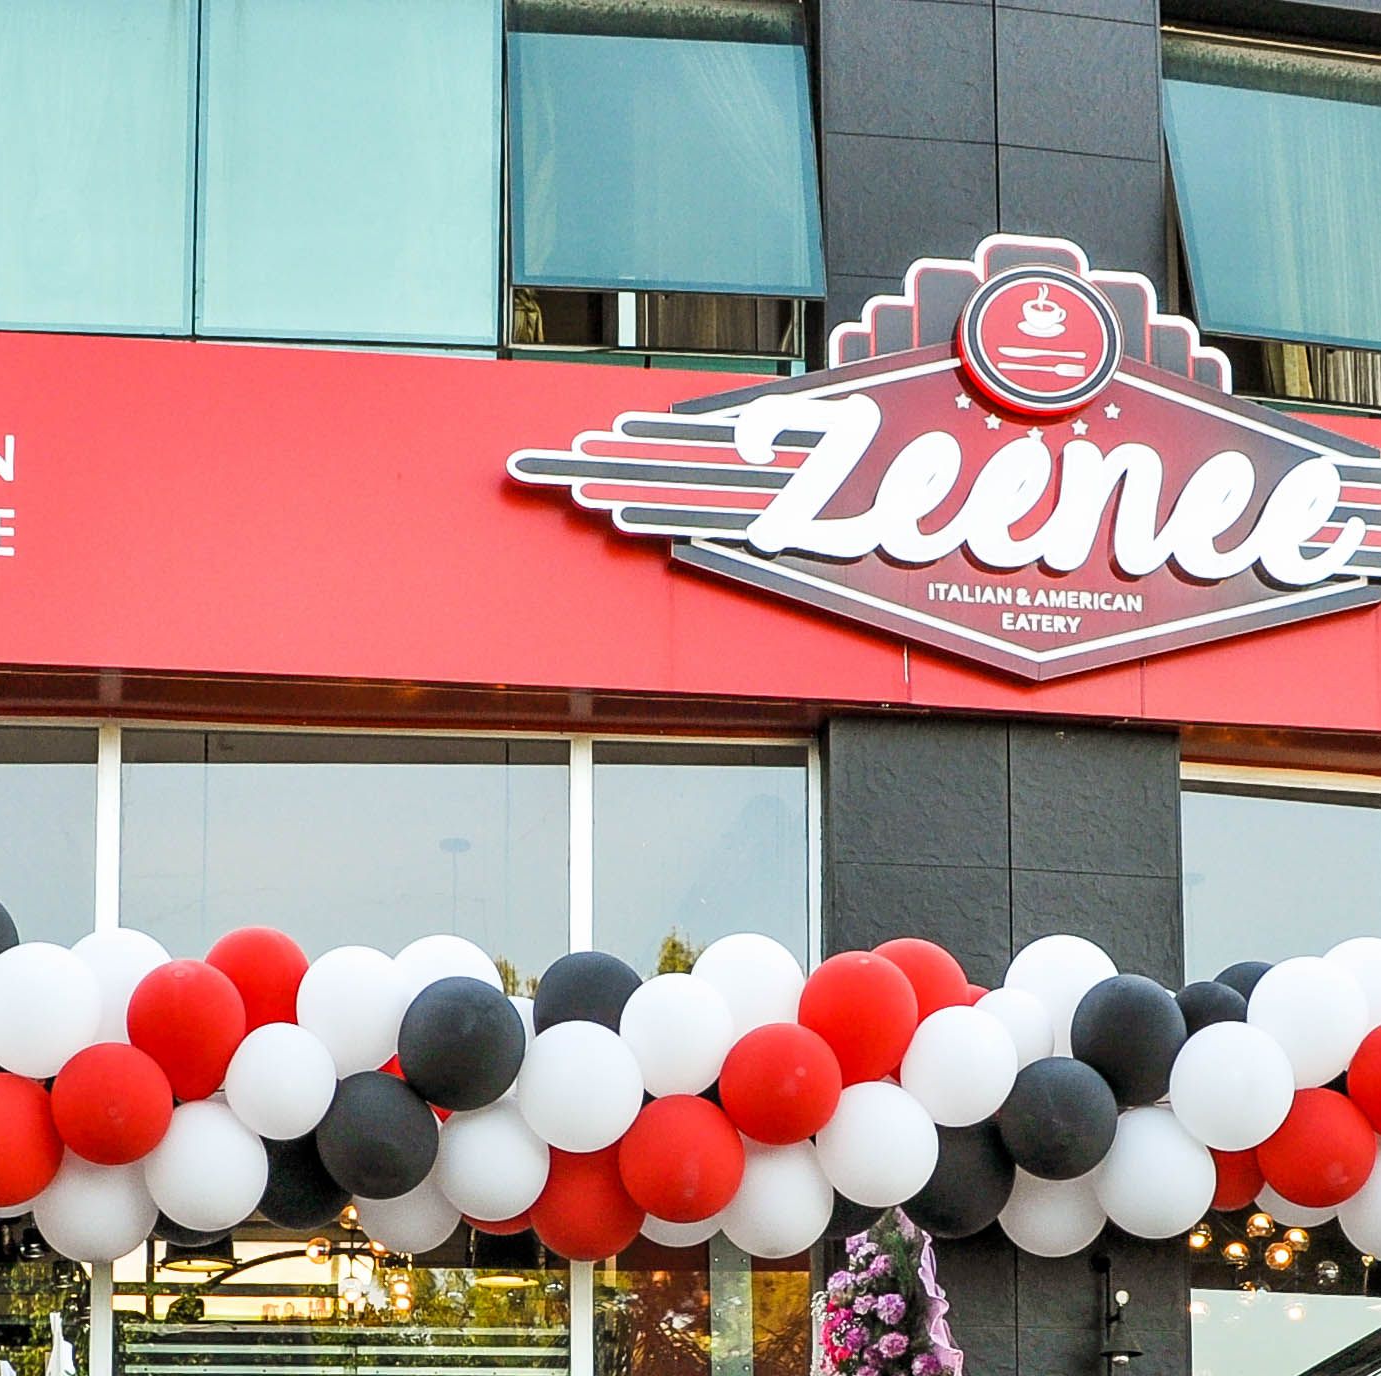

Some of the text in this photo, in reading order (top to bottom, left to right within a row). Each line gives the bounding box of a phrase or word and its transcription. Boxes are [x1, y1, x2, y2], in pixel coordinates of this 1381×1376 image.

[734, 394, 1365, 585] Zeenee
[927, 583, 1142, 613] ITALIAN & AMERICAN
[1001, 613, 1081, 636] EATERY
